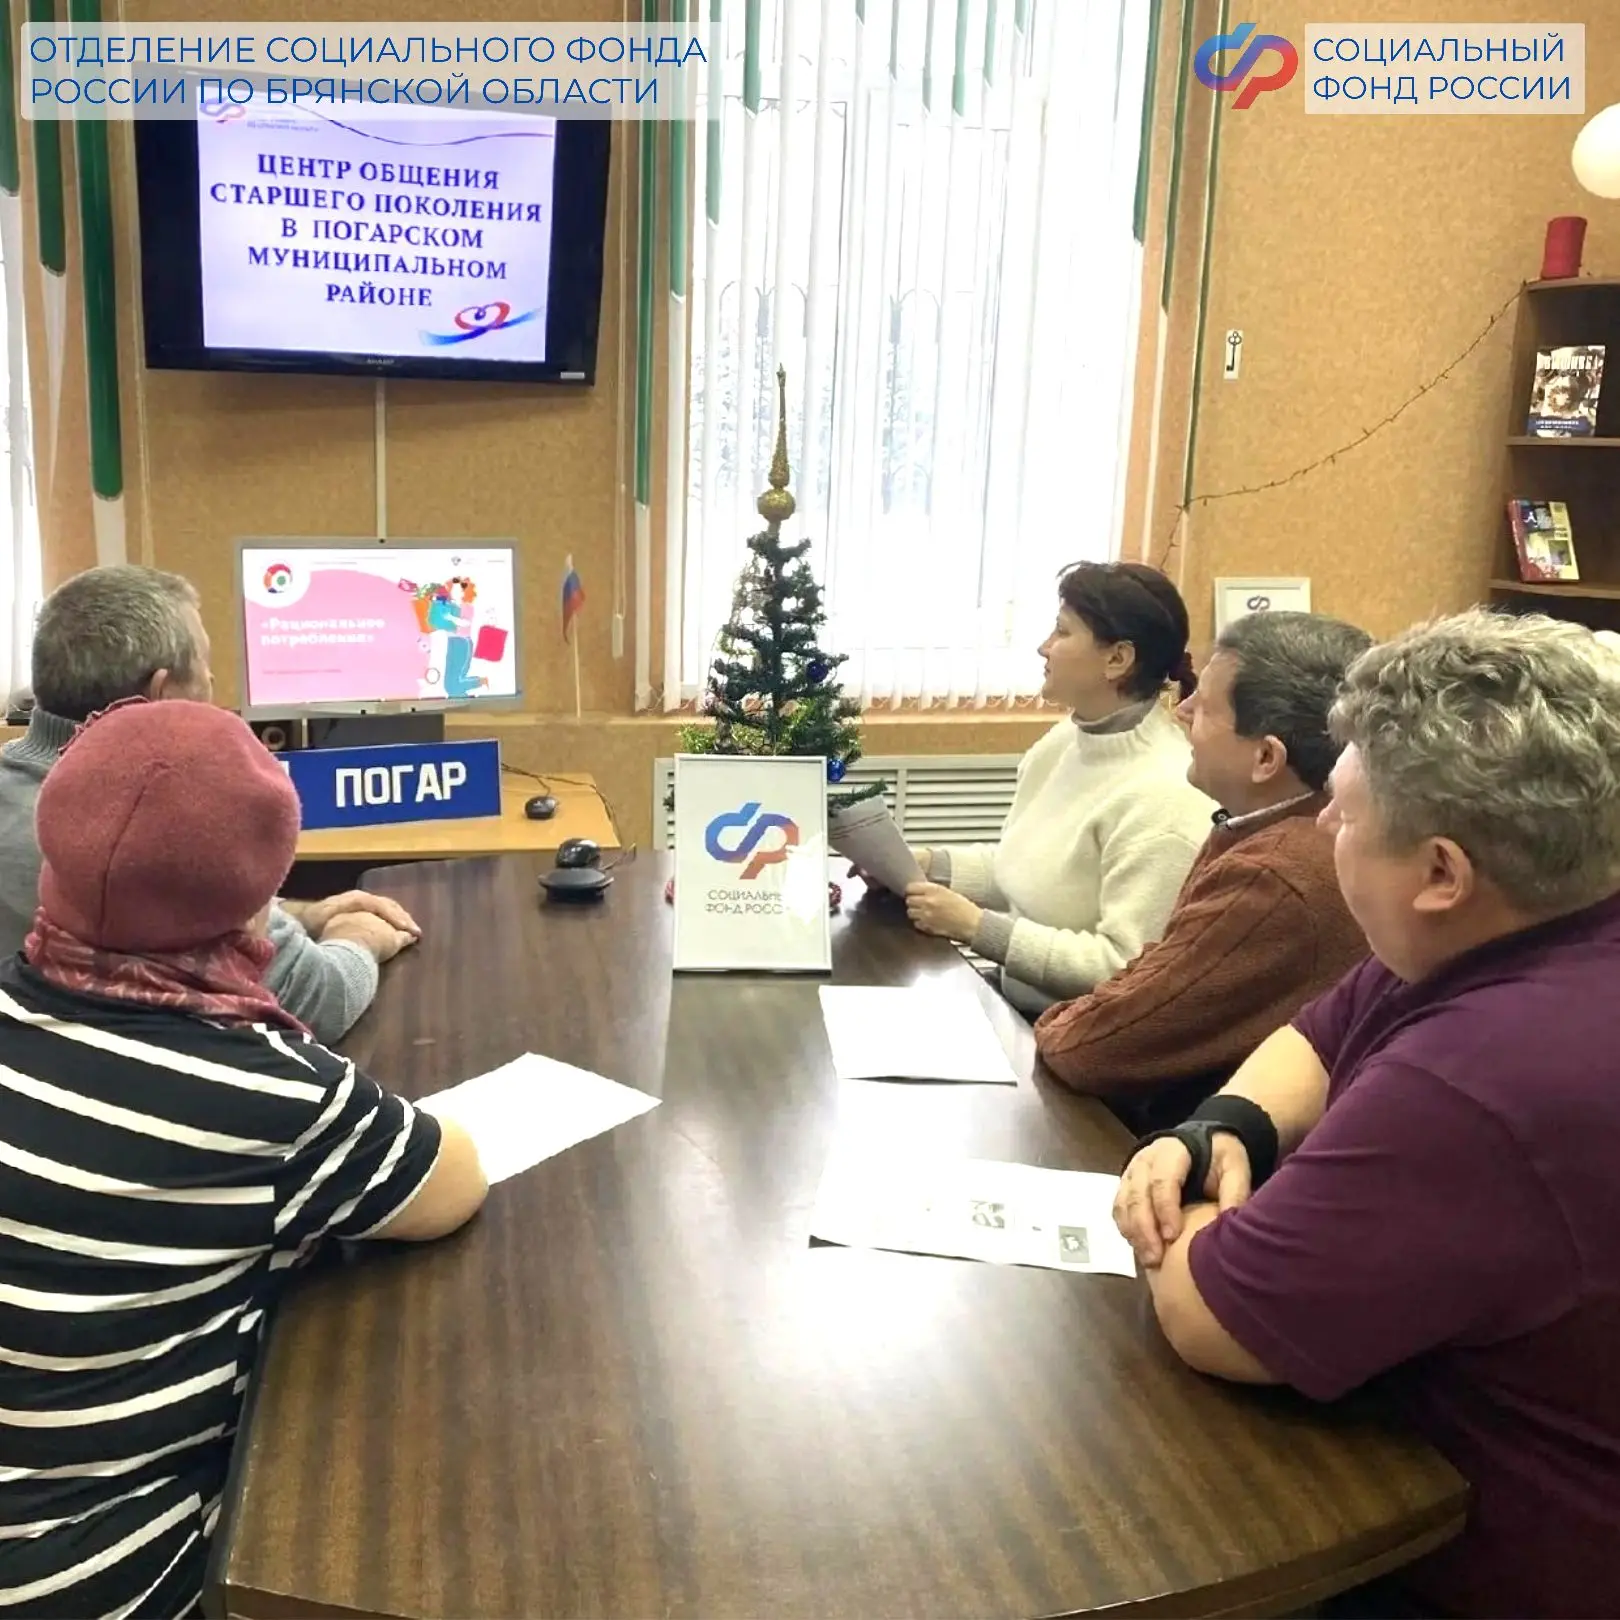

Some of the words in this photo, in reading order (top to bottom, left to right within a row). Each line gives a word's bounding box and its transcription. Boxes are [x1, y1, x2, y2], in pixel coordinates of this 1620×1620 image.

[257, 153, 352, 180] ЦЕНТР
[359, 161, 500, 190] ОБЩЕНИЯ
[210, 183, 366, 212] СТАРШЕГО
[374, 193, 543, 223] ПОКОЛЕНИЯ
[281, 218, 298, 238] В
[313, 219, 484, 249] ПОГАРСКОМ
[248, 246, 508, 280] МУНИЦИПАЛЬНОМ
[326, 280, 433, 307] РАЙОНЕ
[335, 761, 467, 808] ПОГАР
[704, 902, 743, 914] ФОНД
[744, 903, 791, 915] РОСС
[707, 889, 783, 902] СОЦИАЛЬН
